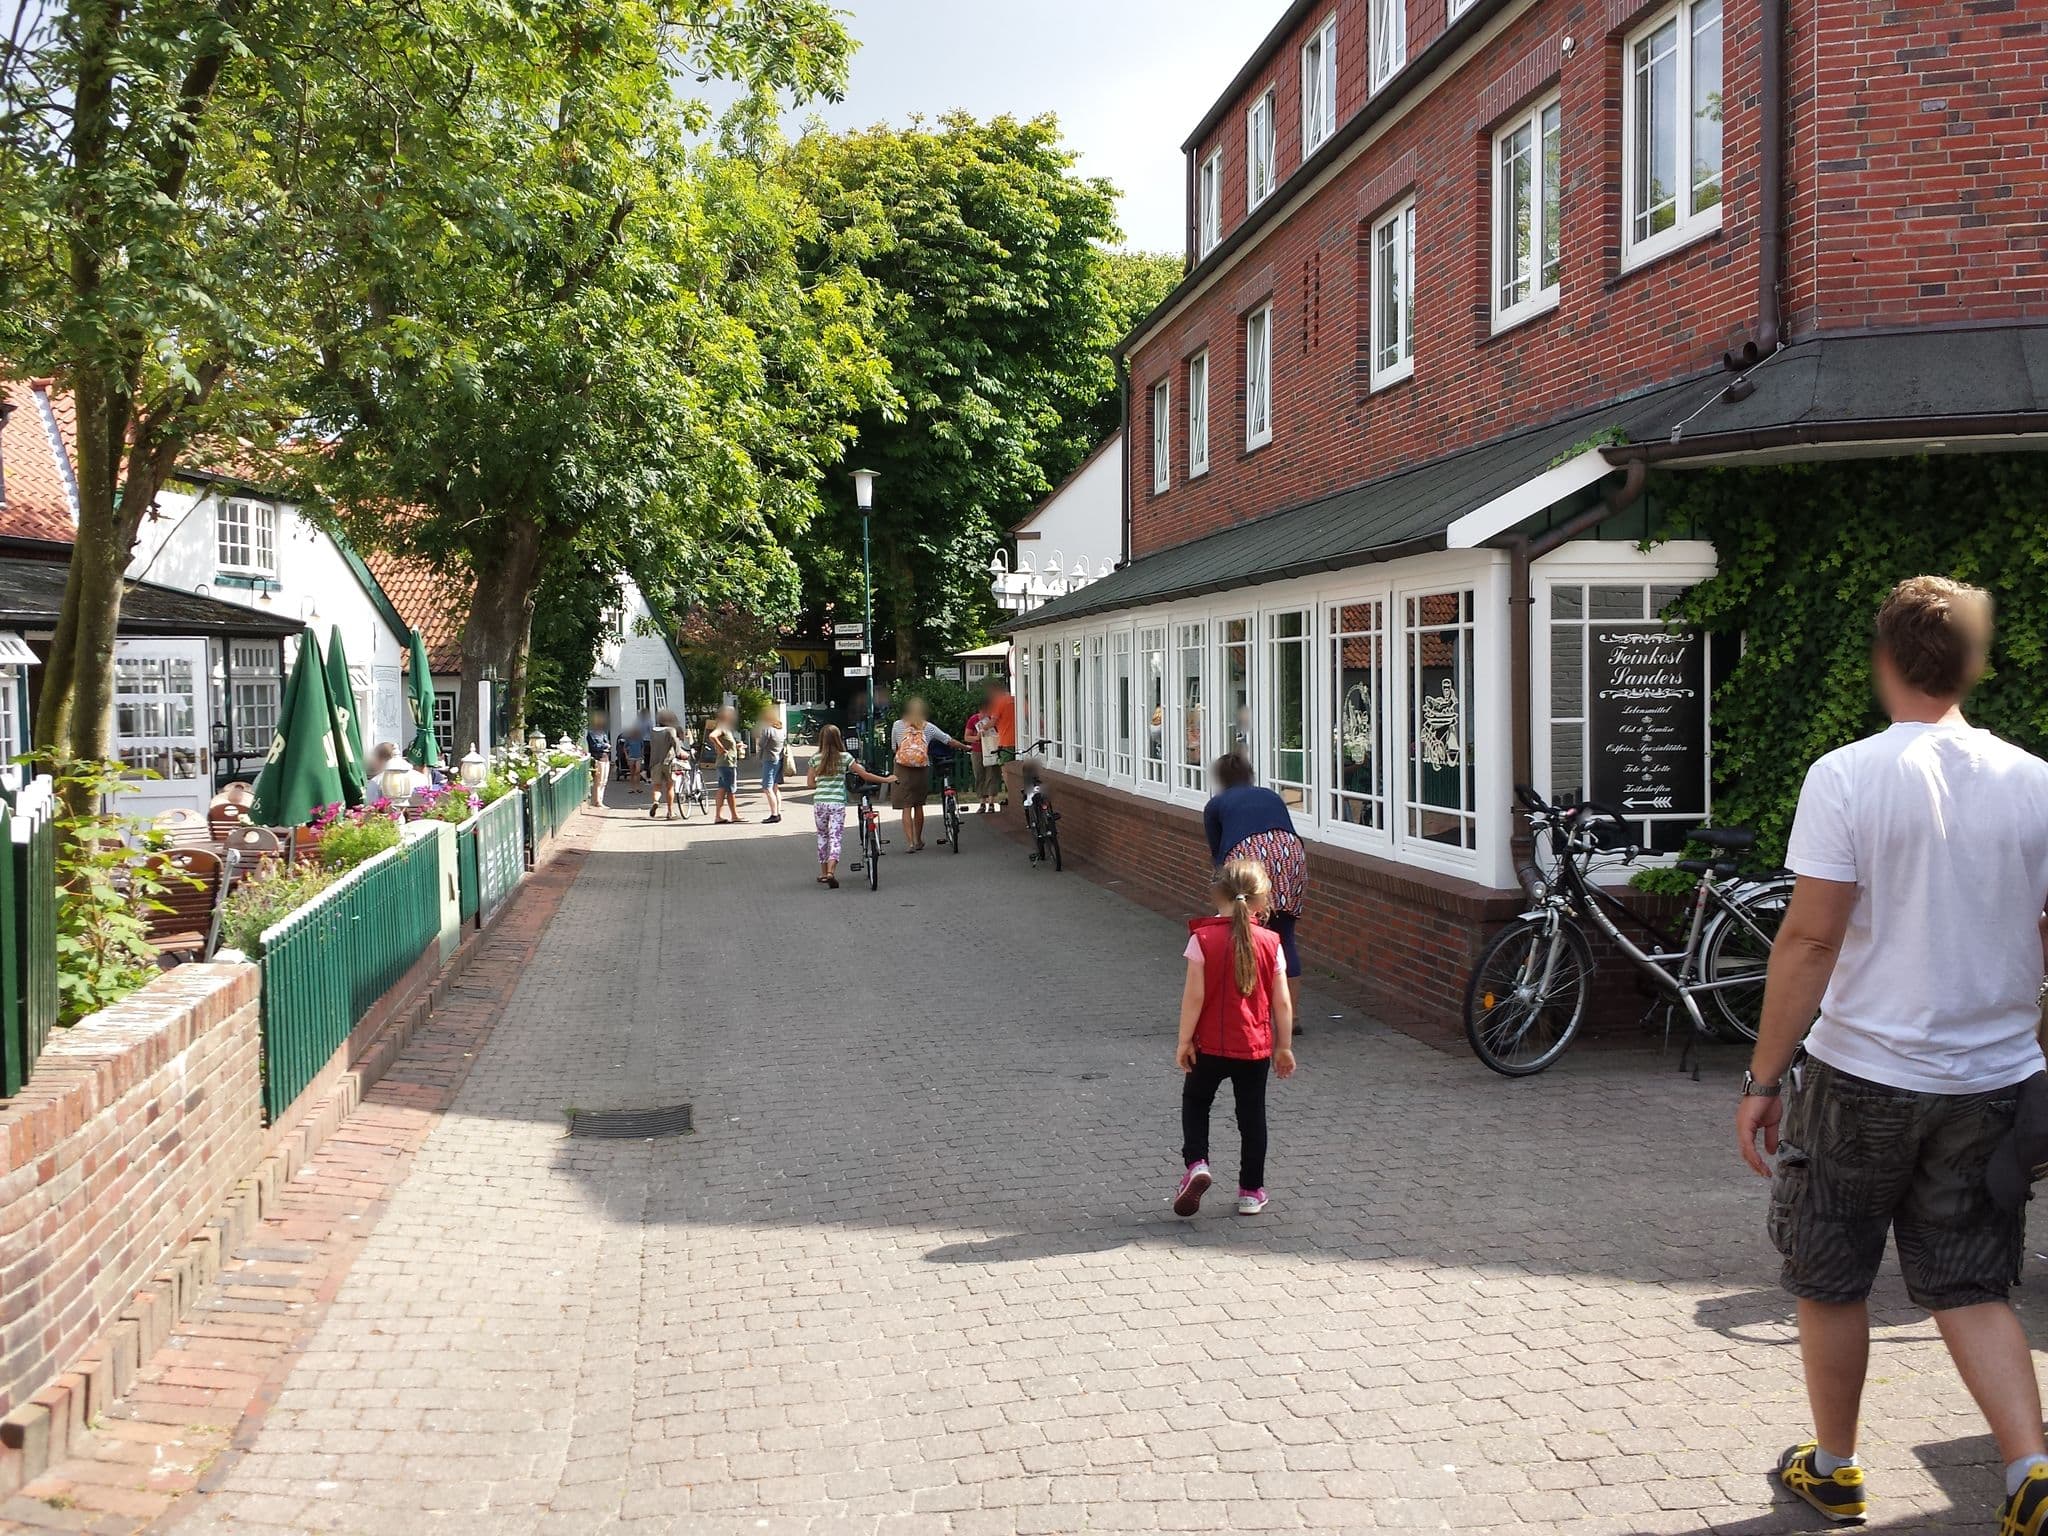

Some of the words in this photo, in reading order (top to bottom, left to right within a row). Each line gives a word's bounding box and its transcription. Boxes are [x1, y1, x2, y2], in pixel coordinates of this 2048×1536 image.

[1608, 646, 1685, 665] Feinkost
[1610, 667, 1682, 685] Sanders
[1621, 705, 1672, 714] Lebensmittel
[1618, 725, 1637, 733] Obst
[1637, 744, 1688, 754] Spezialitäten
[1623, 764, 1640, 772] Toto
[1649, 764, 1671, 772] Lotto
[1622, 784, 1671, 794] Zeitschriften
